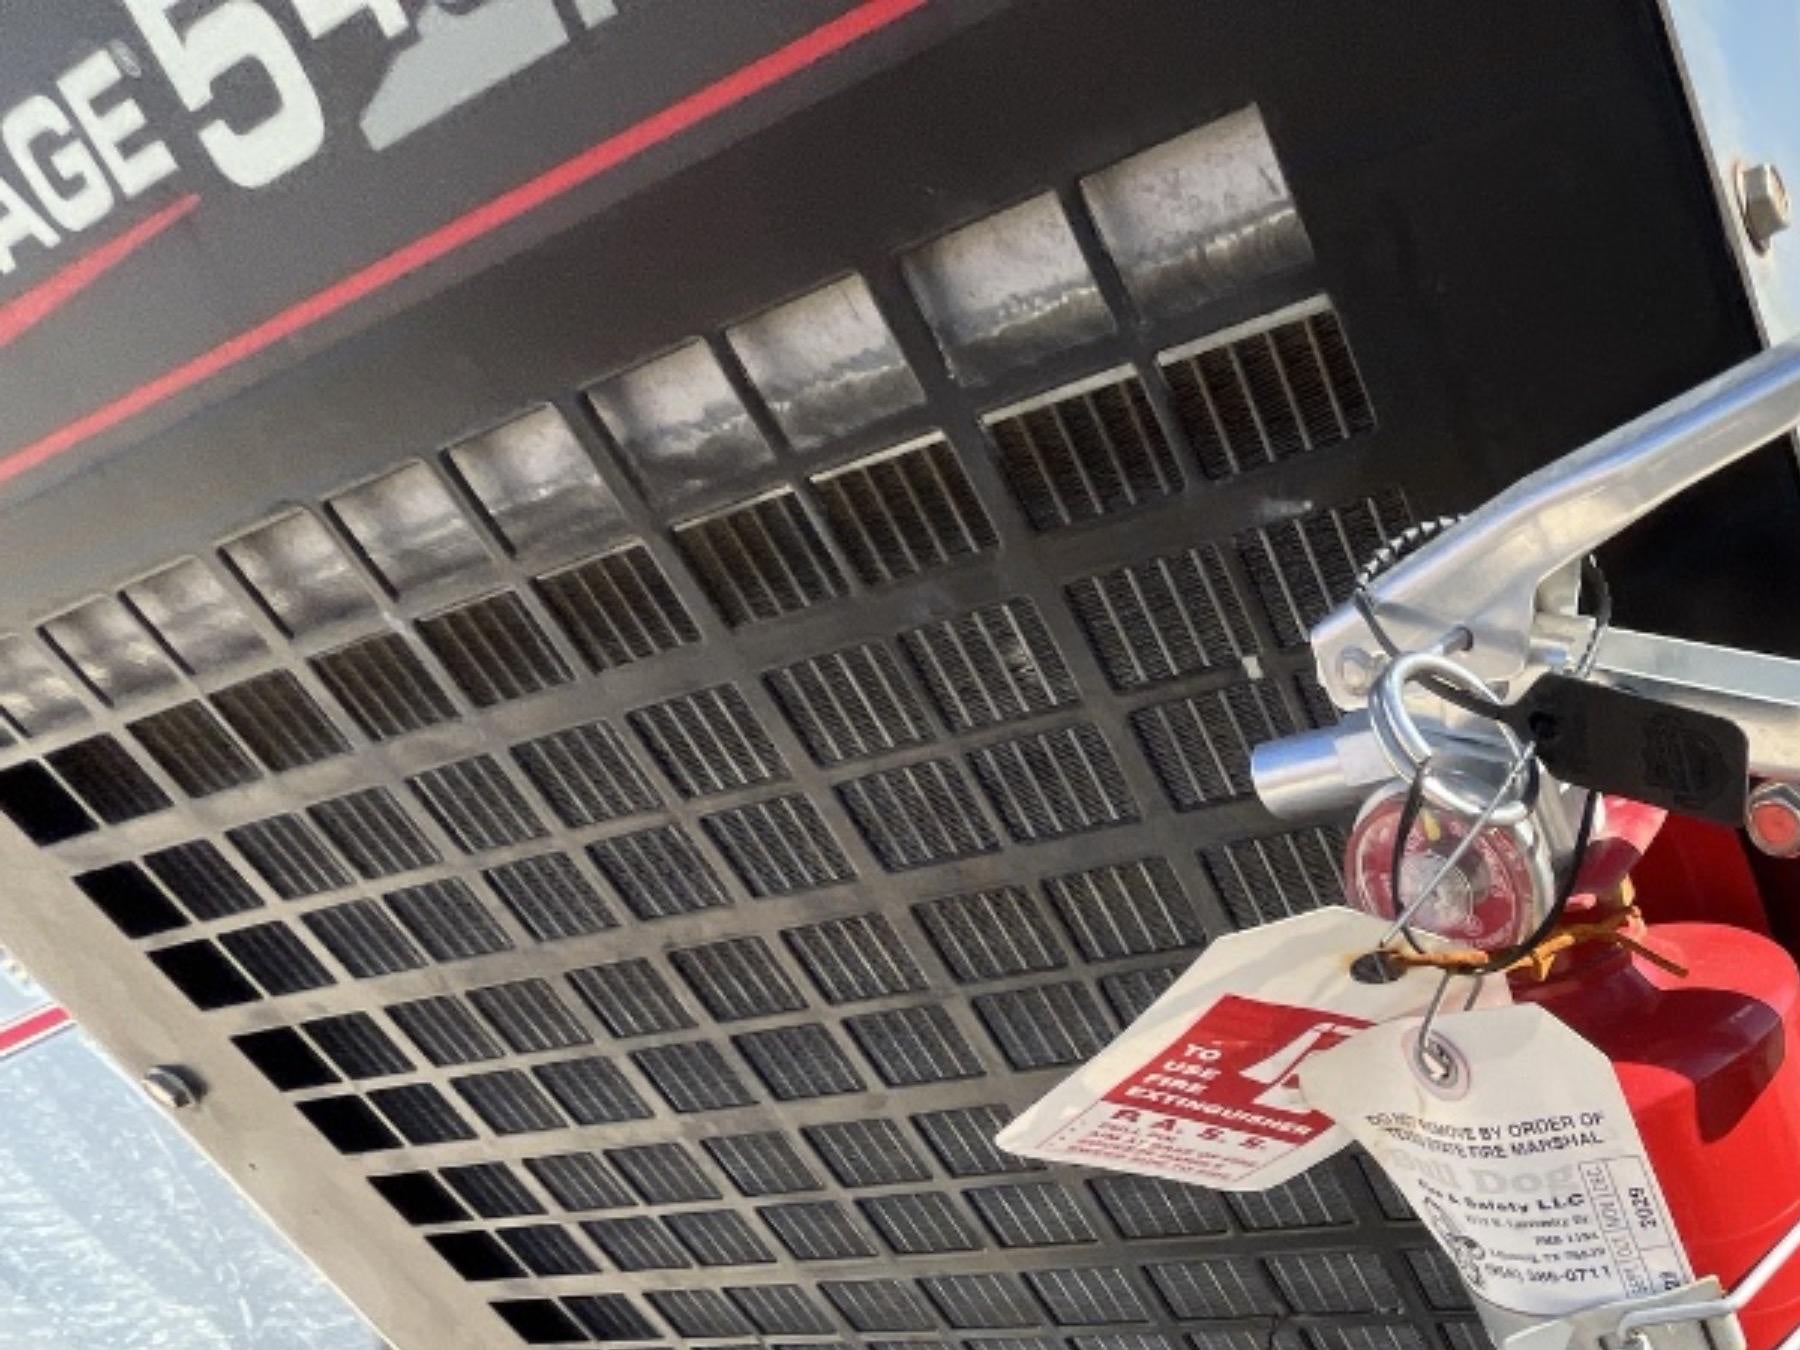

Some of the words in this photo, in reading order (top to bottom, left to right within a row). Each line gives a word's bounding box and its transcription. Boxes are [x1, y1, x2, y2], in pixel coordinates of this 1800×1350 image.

[1184, 1043, 1223, 1062] TO
[1163, 1060, 1222, 1081] USE
[1142, 1072, 1208, 1095] FIRE
[1124, 1085, 1313, 1136] EXTINGUISHER
[1479, 1126, 1502, 1141] BY
[1508, 1114, 1576, 1138] ORDER
[1580, 1109, 1605, 1127] OF
[1511, 1131, 1606, 1156] MARSHAL
[1537, 1192, 1585, 1211] LLC
